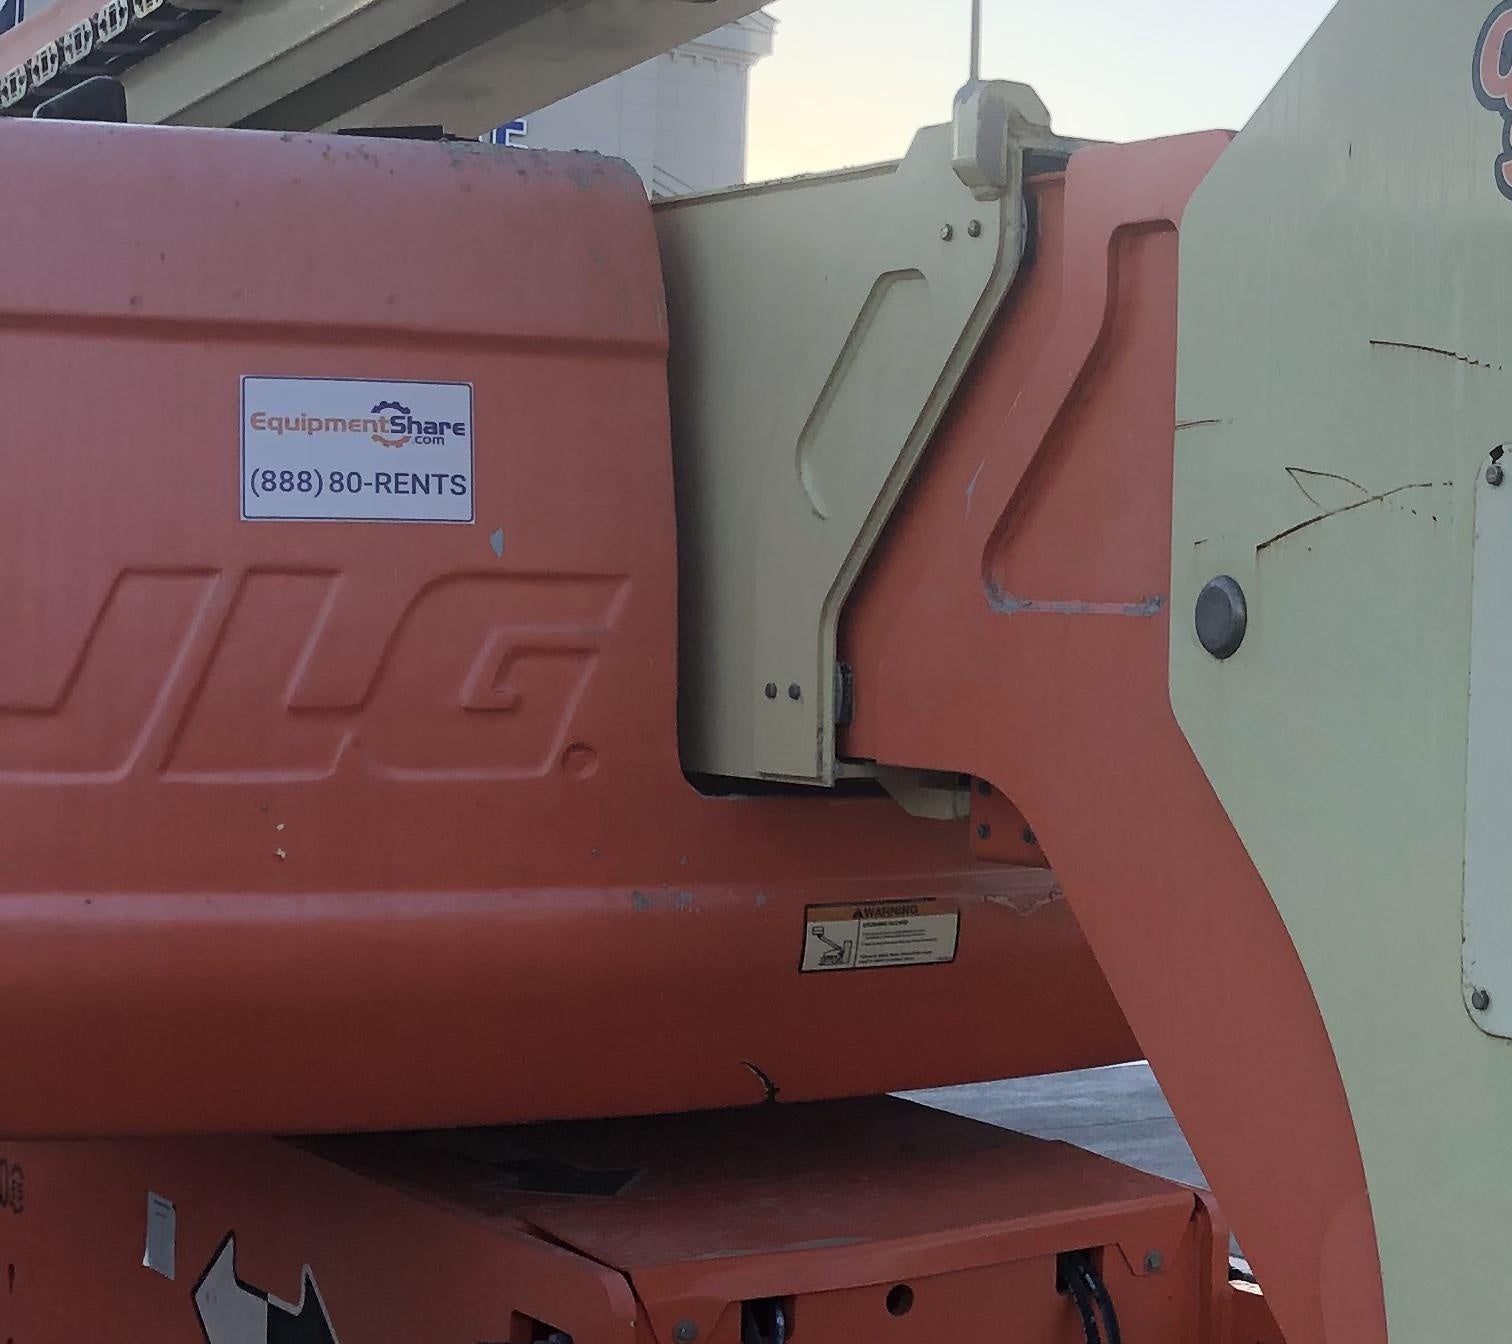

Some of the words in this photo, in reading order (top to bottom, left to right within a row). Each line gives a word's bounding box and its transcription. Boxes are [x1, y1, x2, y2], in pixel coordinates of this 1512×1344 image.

[250, 411, 466, 437] EquipmentShare
[411, 435, 446, 446] .com
[250, 468, 324, 498] (888)
[328, 471, 468, 497] 80-RENTS
[864, 905, 919, 919] WARNING
